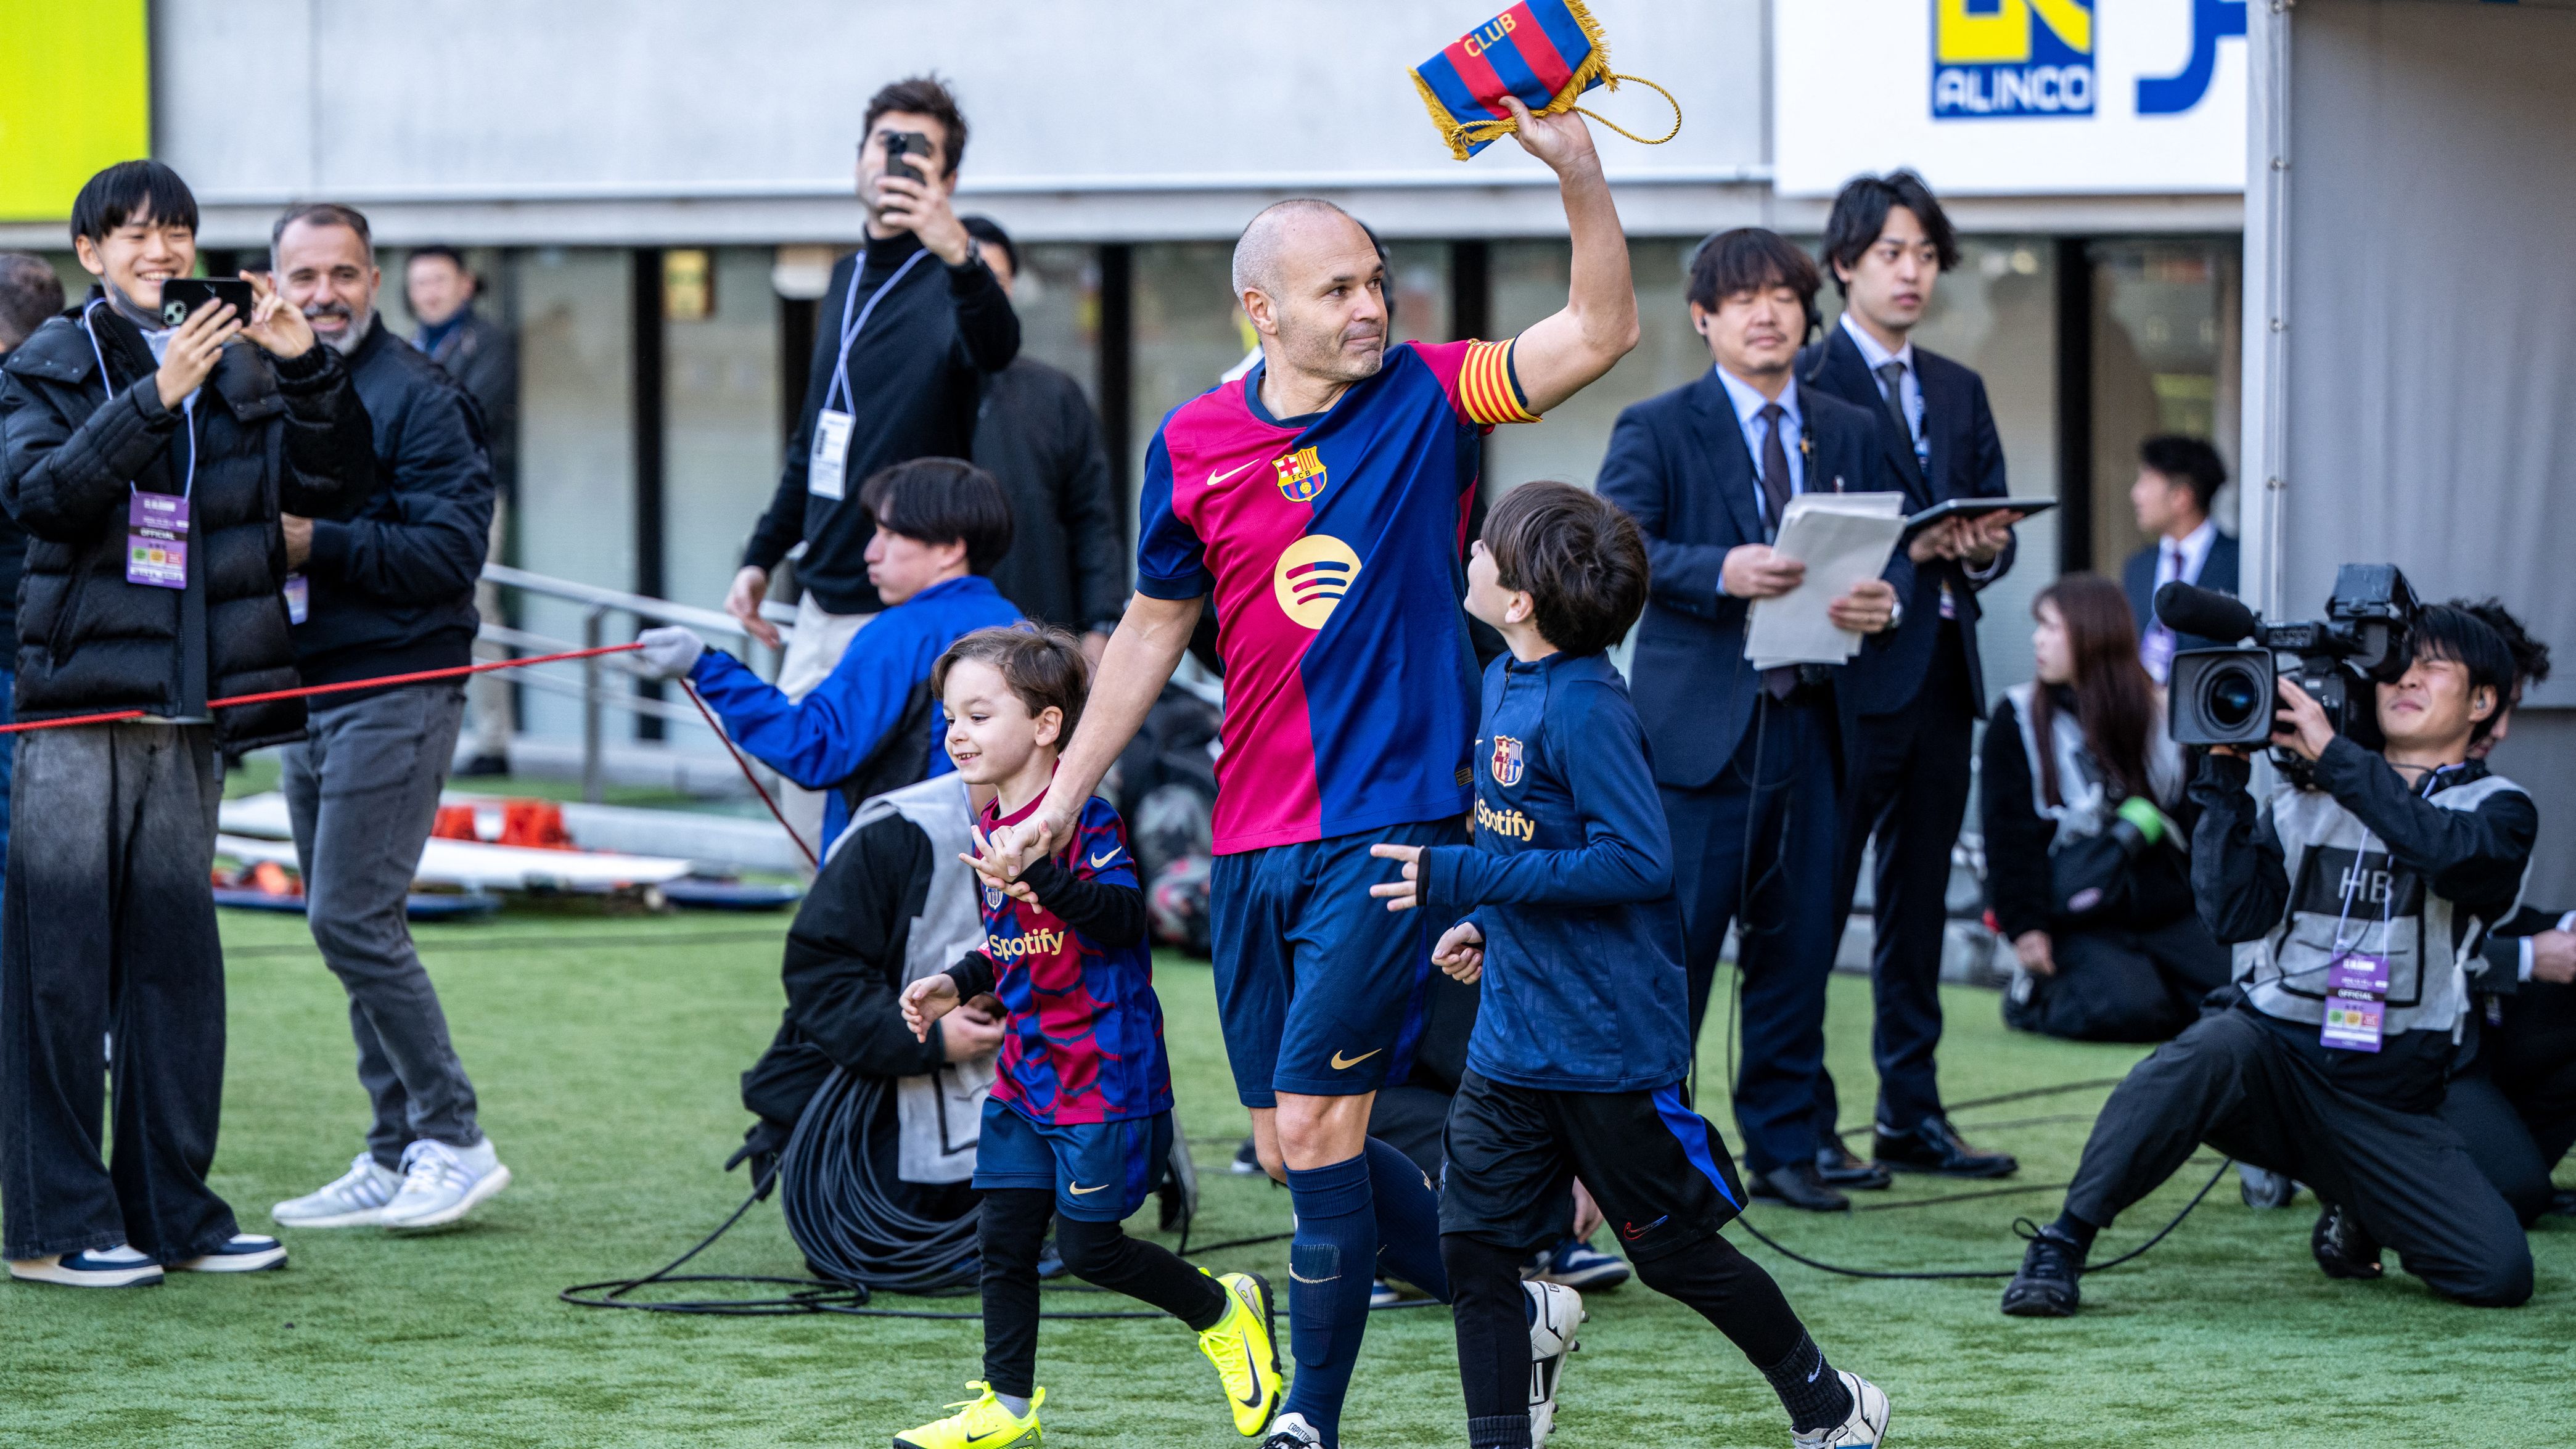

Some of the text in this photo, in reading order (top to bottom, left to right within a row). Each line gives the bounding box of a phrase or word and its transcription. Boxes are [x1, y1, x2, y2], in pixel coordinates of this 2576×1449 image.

[1464, 13, 1517, 57] CLUB
[1935, 65, 2092, 113] ALINCO
[141, 527, 175, 541] OFFICIAL
[1478, 798, 1535, 842] Spotify
[989, 928, 1064, 961] Spotify
[2337, 988, 2374, 1001] OFFICIAL
